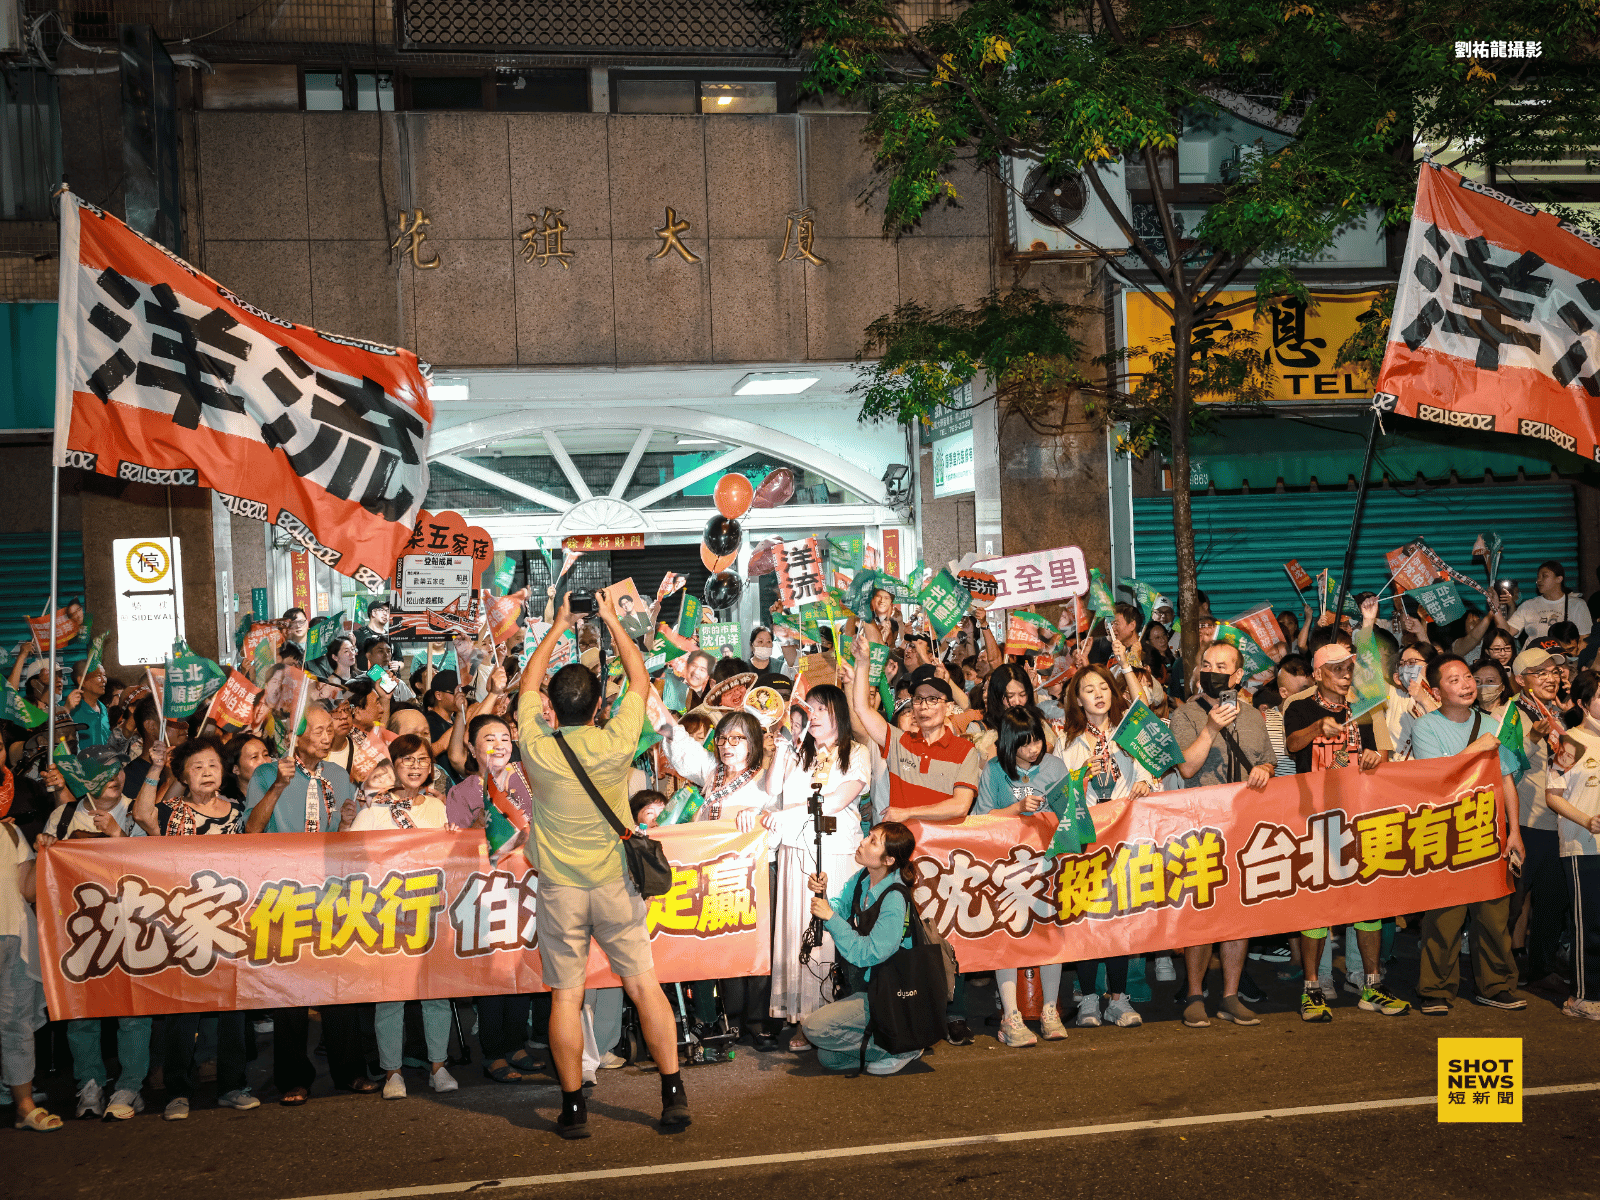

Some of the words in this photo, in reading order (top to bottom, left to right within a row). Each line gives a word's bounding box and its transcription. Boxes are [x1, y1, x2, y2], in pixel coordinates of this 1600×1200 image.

[86, 265, 426, 523] 洋流
[1419, 403, 1494, 431] 20261128
[1520, 419, 1577, 453] 20261128
[119, 461, 196, 486] 20261128
[780, 543, 824, 601] 洋流
[702, 633, 739, 647] 沈伯洋
[167, 663, 204, 683] 台北
[1133, 728, 1174, 766] 順起來
[1145, 721, 1174, 747] 台北
[917, 832, 1224, 935] 沈家挺伯洋
[1242, 790, 1502, 898] 台北更有望
[68, 872, 440, 976] 沈家作伙行
[896, 988, 919, 1000] dyson
